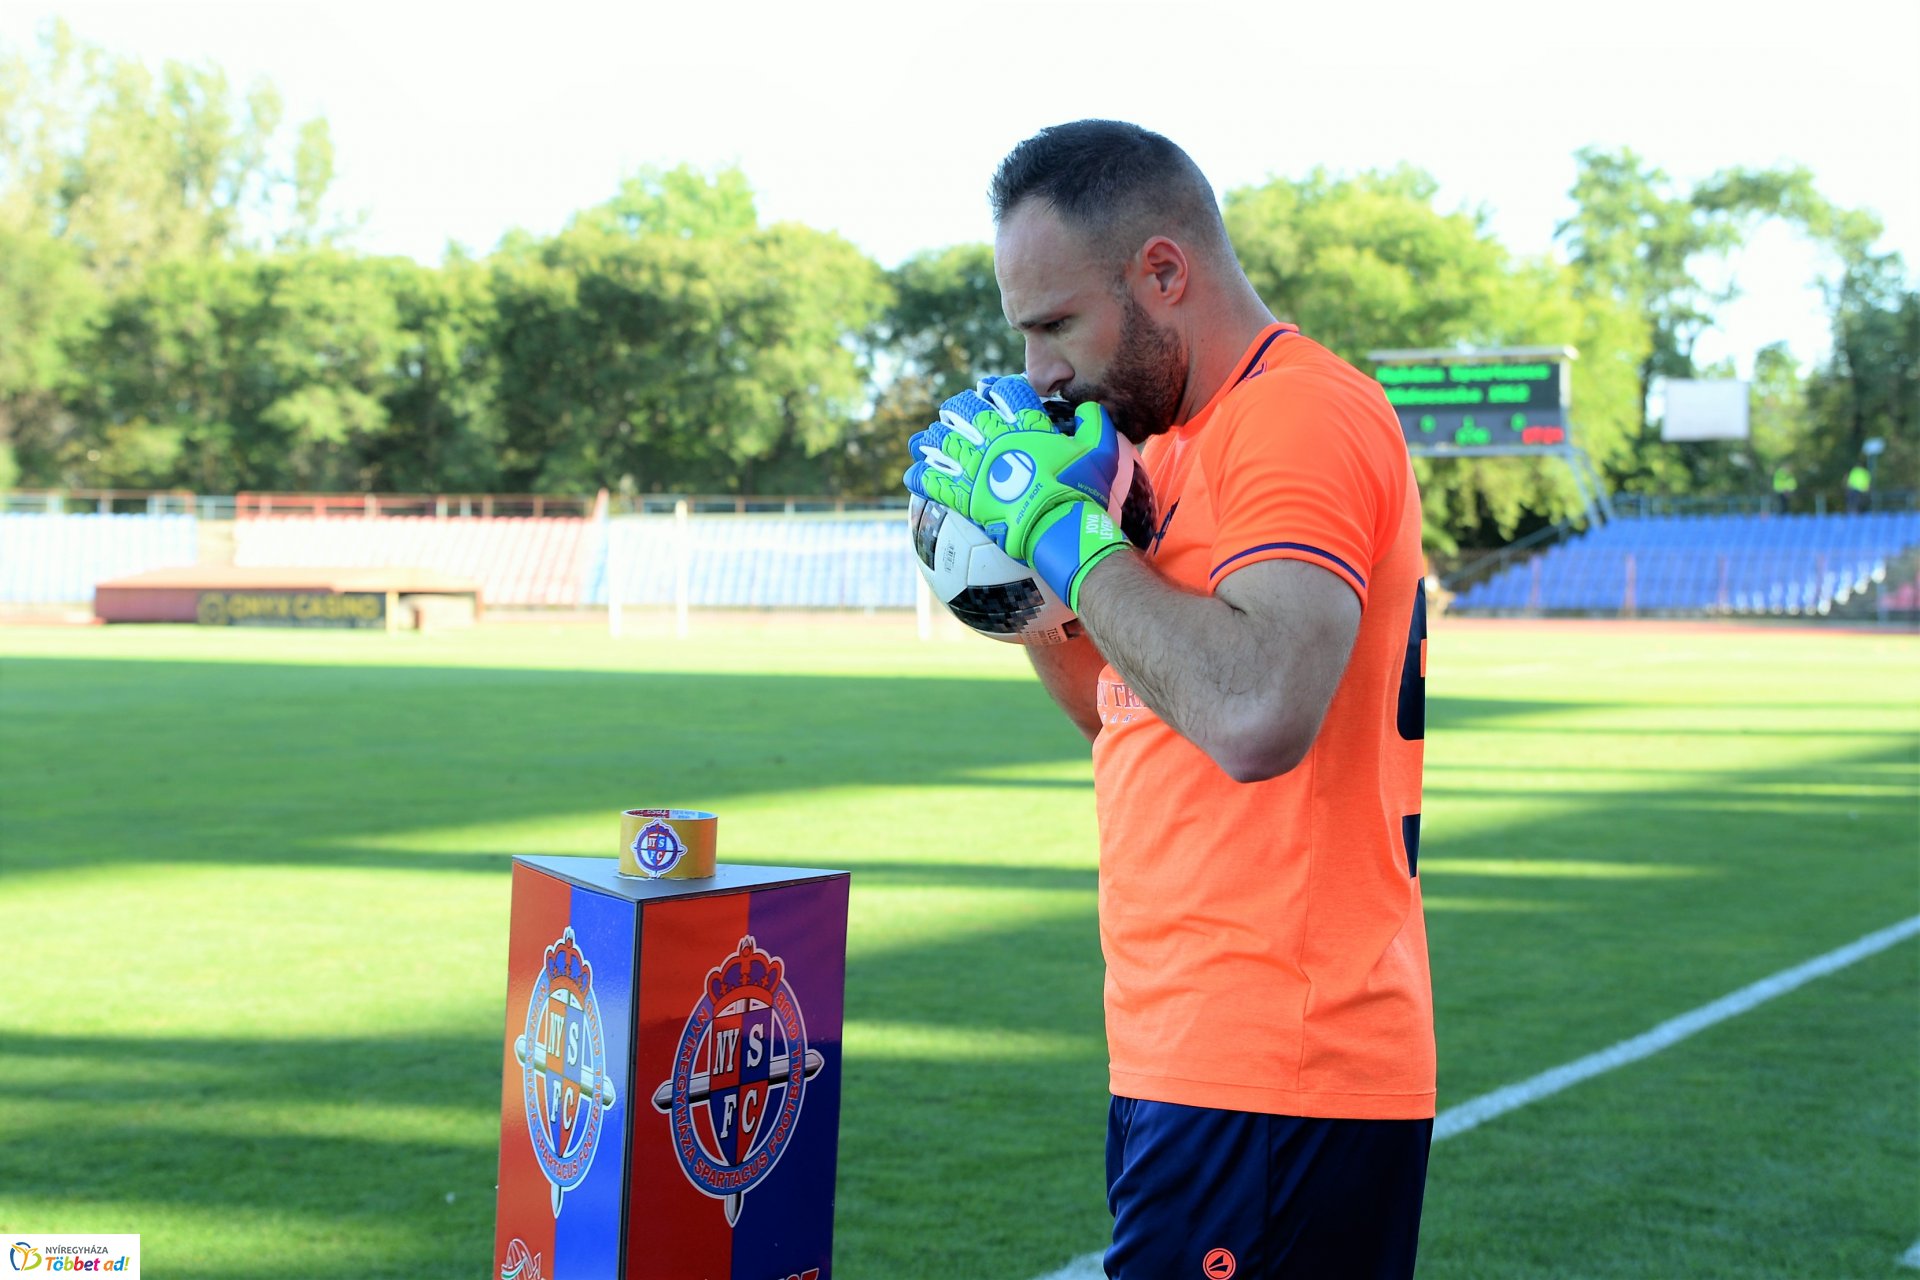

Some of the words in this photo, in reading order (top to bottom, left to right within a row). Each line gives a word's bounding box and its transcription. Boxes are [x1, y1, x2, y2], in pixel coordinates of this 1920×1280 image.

[1016, 501, 1030, 525] aqua
[1029, 482, 1043, 500] soft
[547, 1011, 565, 1058] NY
[567, 1021, 579, 1065] S
[775, 991, 800, 1040] CLUB
[713, 1028, 740, 1075] NY
[747, 1023, 764, 1067] S
[550, 1080, 562, 1123] F
[563, 1087, 574, 1130] C
[720, 1093, 737, 1138] F
[741, 1089, 758, 1133] C
[768, 1045, 803, 1157] FOOTBALL
[694, 1152, 769, 1189] SPARTACUS
